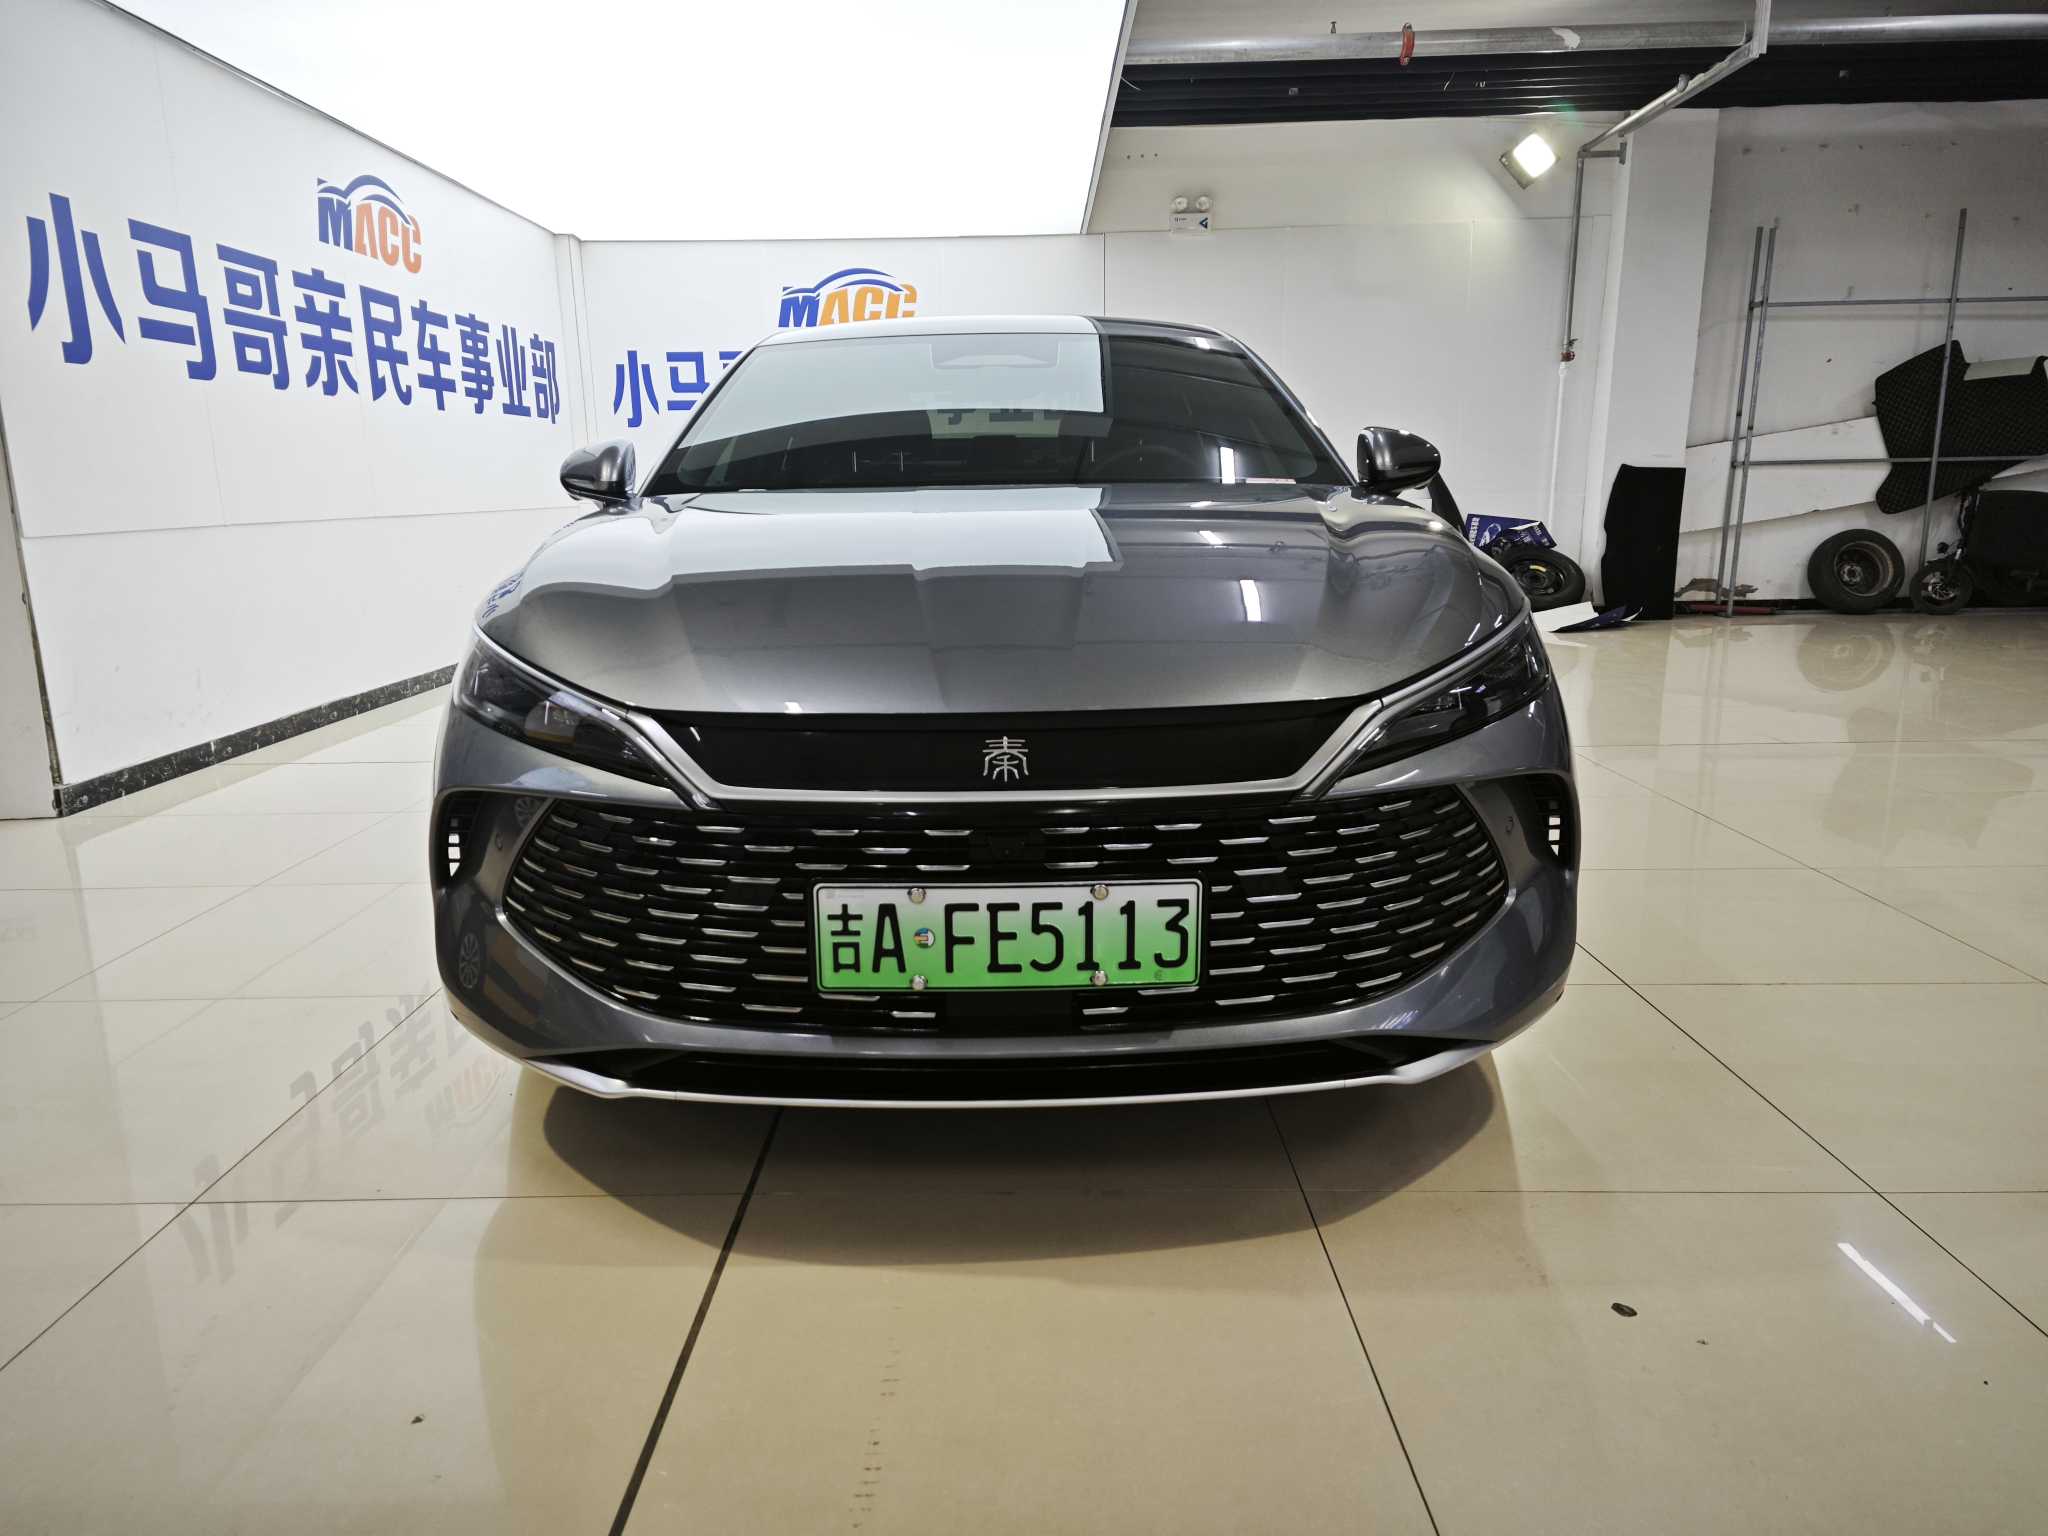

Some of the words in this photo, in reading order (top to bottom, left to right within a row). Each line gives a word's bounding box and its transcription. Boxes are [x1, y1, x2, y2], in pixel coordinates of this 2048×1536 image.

[317, 196, 422, 274] MACC
[26, 192, 561, 424] 小马哥亲民车事业部
[613, 350, 743, 428] 小马
